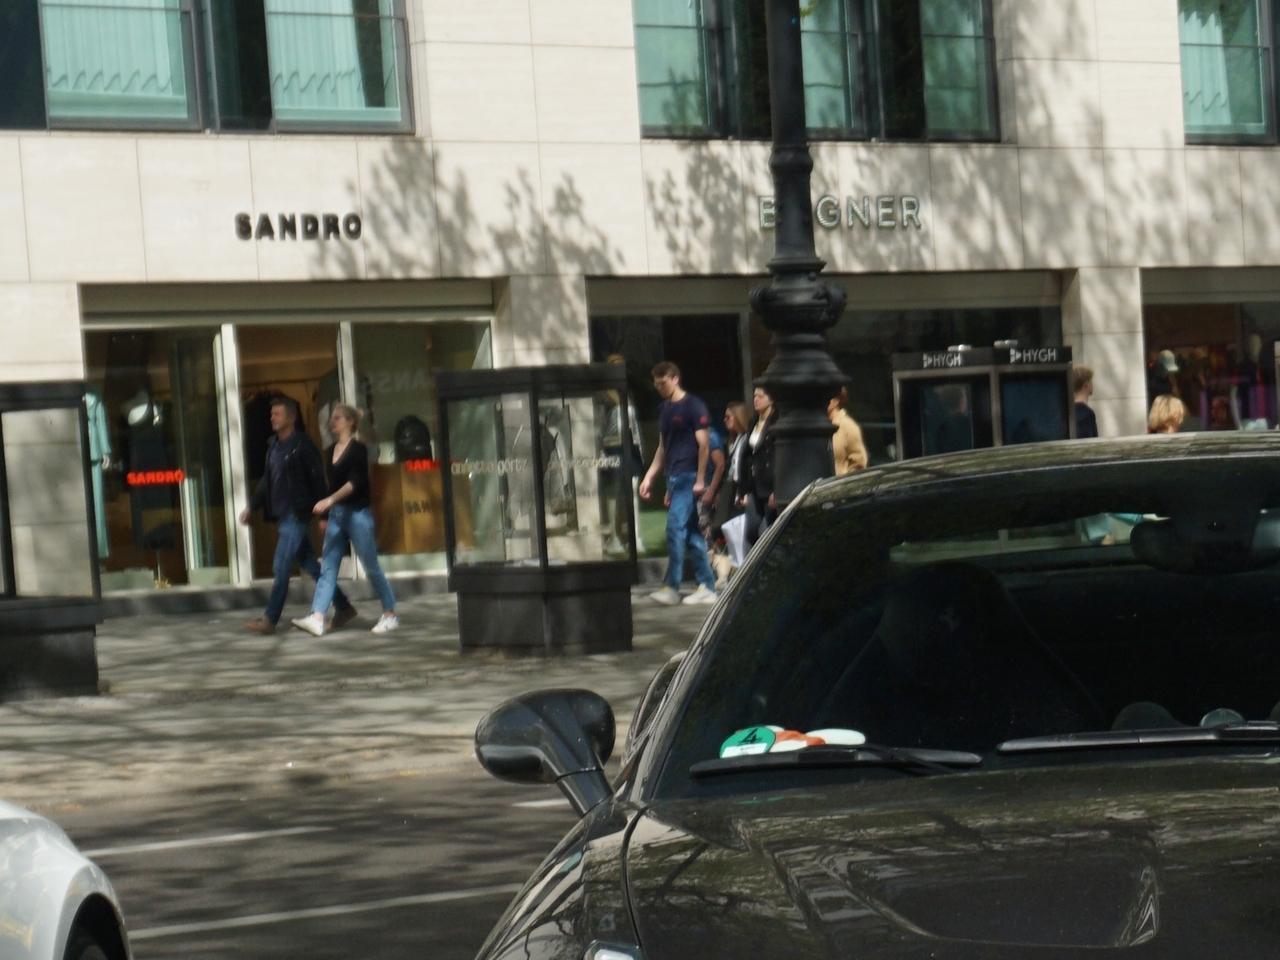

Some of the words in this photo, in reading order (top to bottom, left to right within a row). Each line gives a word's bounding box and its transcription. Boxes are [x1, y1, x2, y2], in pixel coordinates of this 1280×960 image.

[758, 195, 921, 229] BGNER
[234, 212, 362, 241] SANDRO
[933, 353, 962, 367] HYGH
[1023, 349, 1057, 363] HYGH
[127, 469, 184, 485] SANDRO
